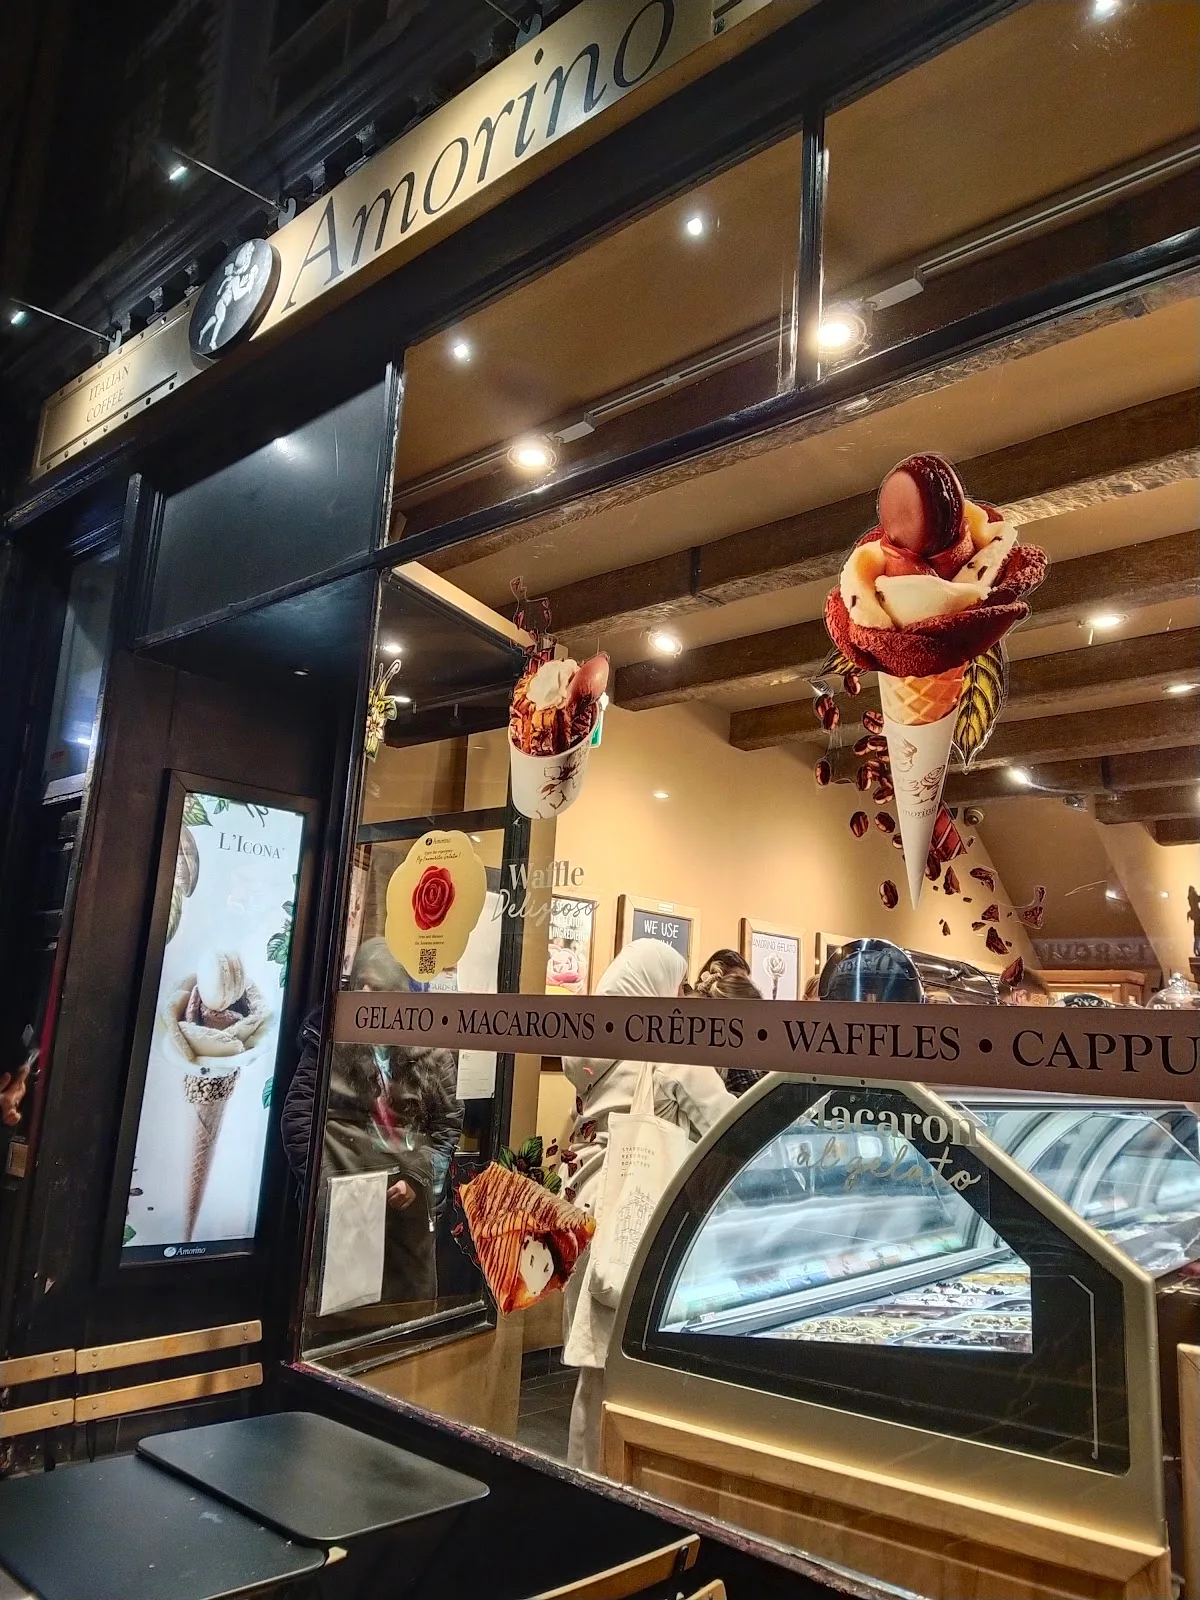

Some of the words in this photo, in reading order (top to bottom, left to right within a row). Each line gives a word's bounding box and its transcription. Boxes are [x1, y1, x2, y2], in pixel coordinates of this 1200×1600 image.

[281, 0, 675, 312] Amorino
[89, 362, 132, 402] ITALIAN
[86, 387, 125, 423] COFFEE
[508, 860, 585, 890] Waffle
[491, 888, 600, 927] Delizioso
[644, 919, 658, 935] WE
[661, 922, 679, 939] USE
[355, 1005, 434, 1032] GELATO
[456, 1008, 595, 1040] MACARONS
[624, 1008, 744, 1048] CRÊPES
[782, 1019, 961, 1062] WAFFLES
[1012, 1030, 1200, 1076] CAPPU
[844, 1144, 982, 1192] gelato
[176, 1246, 206, 1256] Amorino
